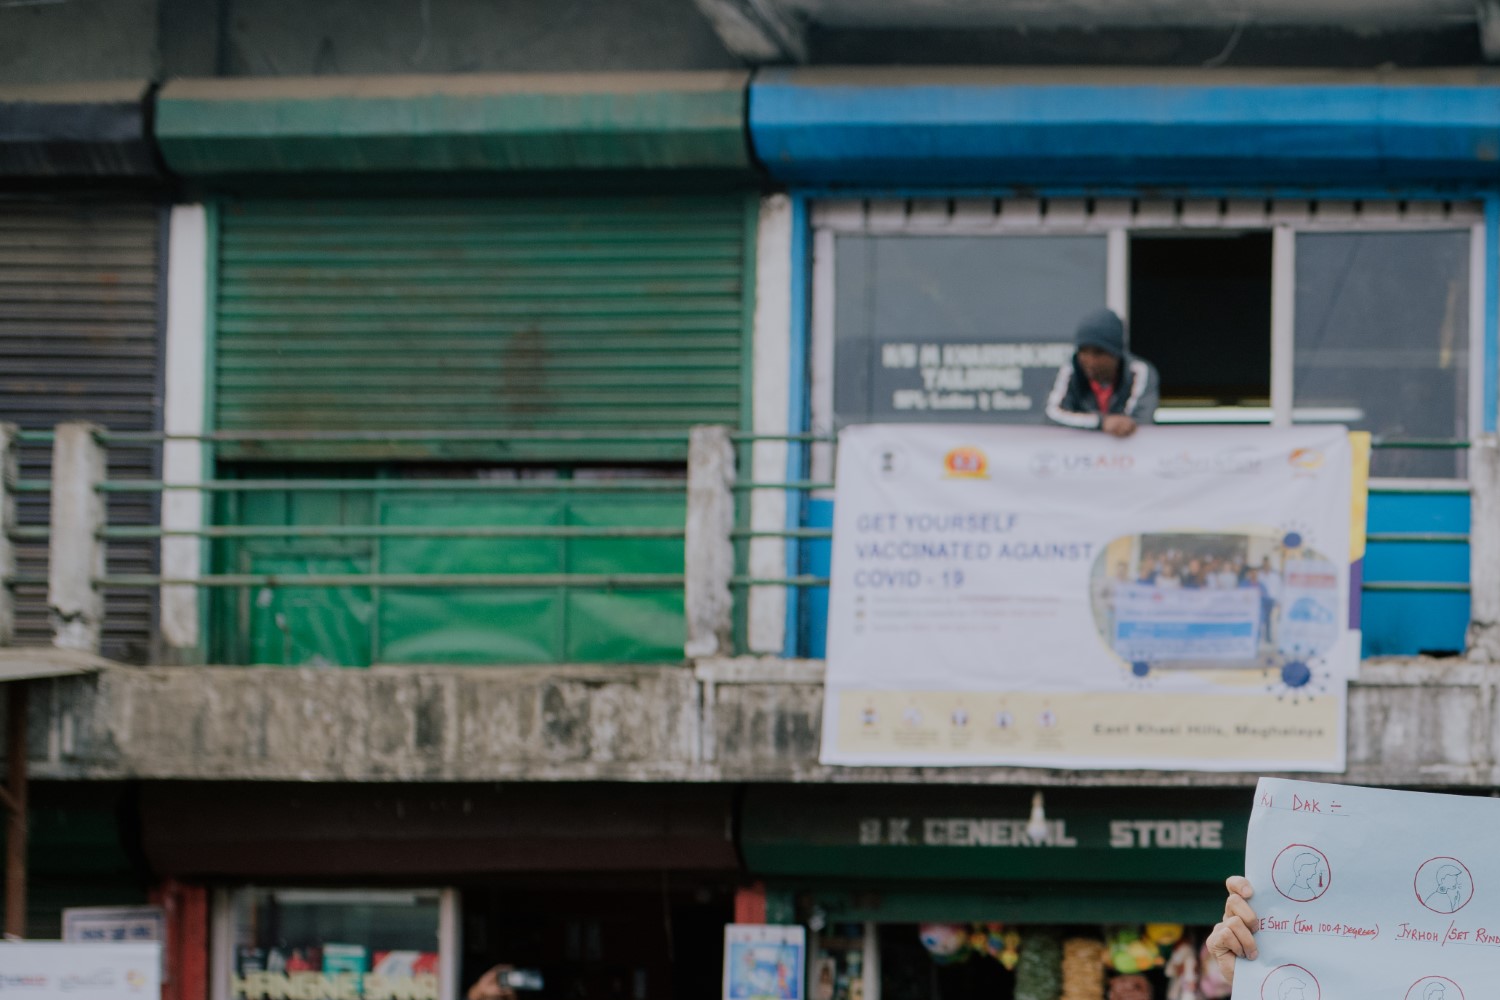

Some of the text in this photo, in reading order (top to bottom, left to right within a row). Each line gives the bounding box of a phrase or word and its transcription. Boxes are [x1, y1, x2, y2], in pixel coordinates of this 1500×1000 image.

[1063, 455, 1135, 471] USAID
[856, 513, 1019, 533] GET YOURSELF
[855, 541, 1094, 561] VACCINATED AGAINST
[853, 569, 965, 589] COVID 19
[1093, 723, 1129, 737] East
[1292, 794, 1322, 814] DAK
[1109, 819, 1224, 848] STORE
